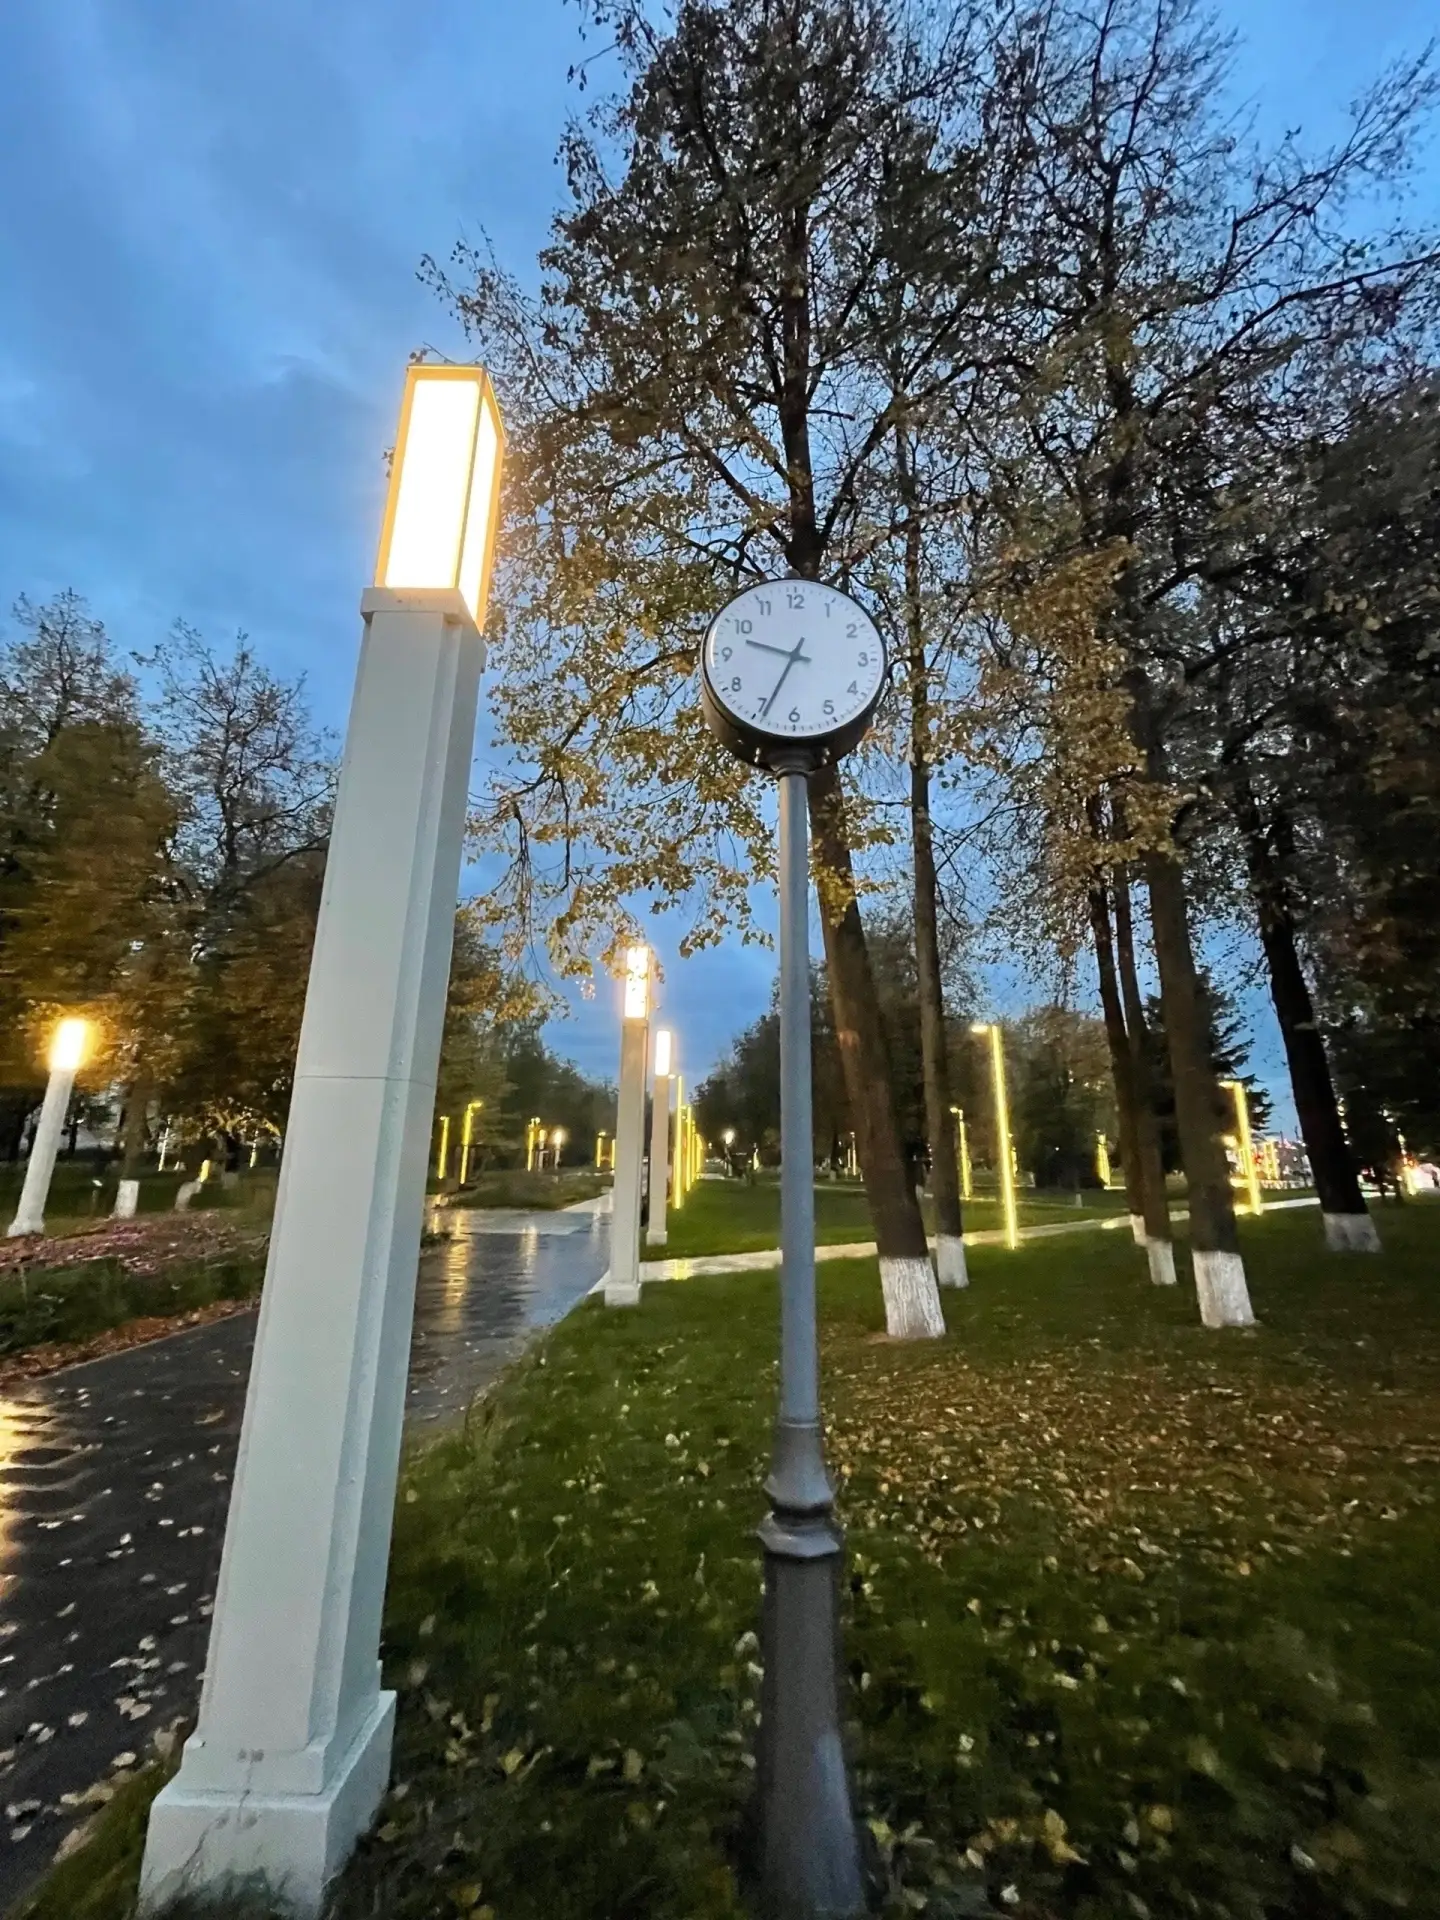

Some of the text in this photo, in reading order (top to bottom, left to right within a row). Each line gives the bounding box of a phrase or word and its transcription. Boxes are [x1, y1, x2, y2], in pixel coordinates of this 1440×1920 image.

[759, 601, 771, 615] 11
[786, 594, 804, 609] 12
[824, 603, 830, 617] 1
[735, 620, 752, 634] 10
[846, 624, 857, 638] 2
[722, 647, 733, 661] 9
[858, 652, 868, 666] 3
[731, 677, 742, 692] 8
[847, 680, 858, 694] 4
[758, 698, 767, 712] 7
[823, 700, 834, 714] 5
[789, 707, 800, 722] 6
